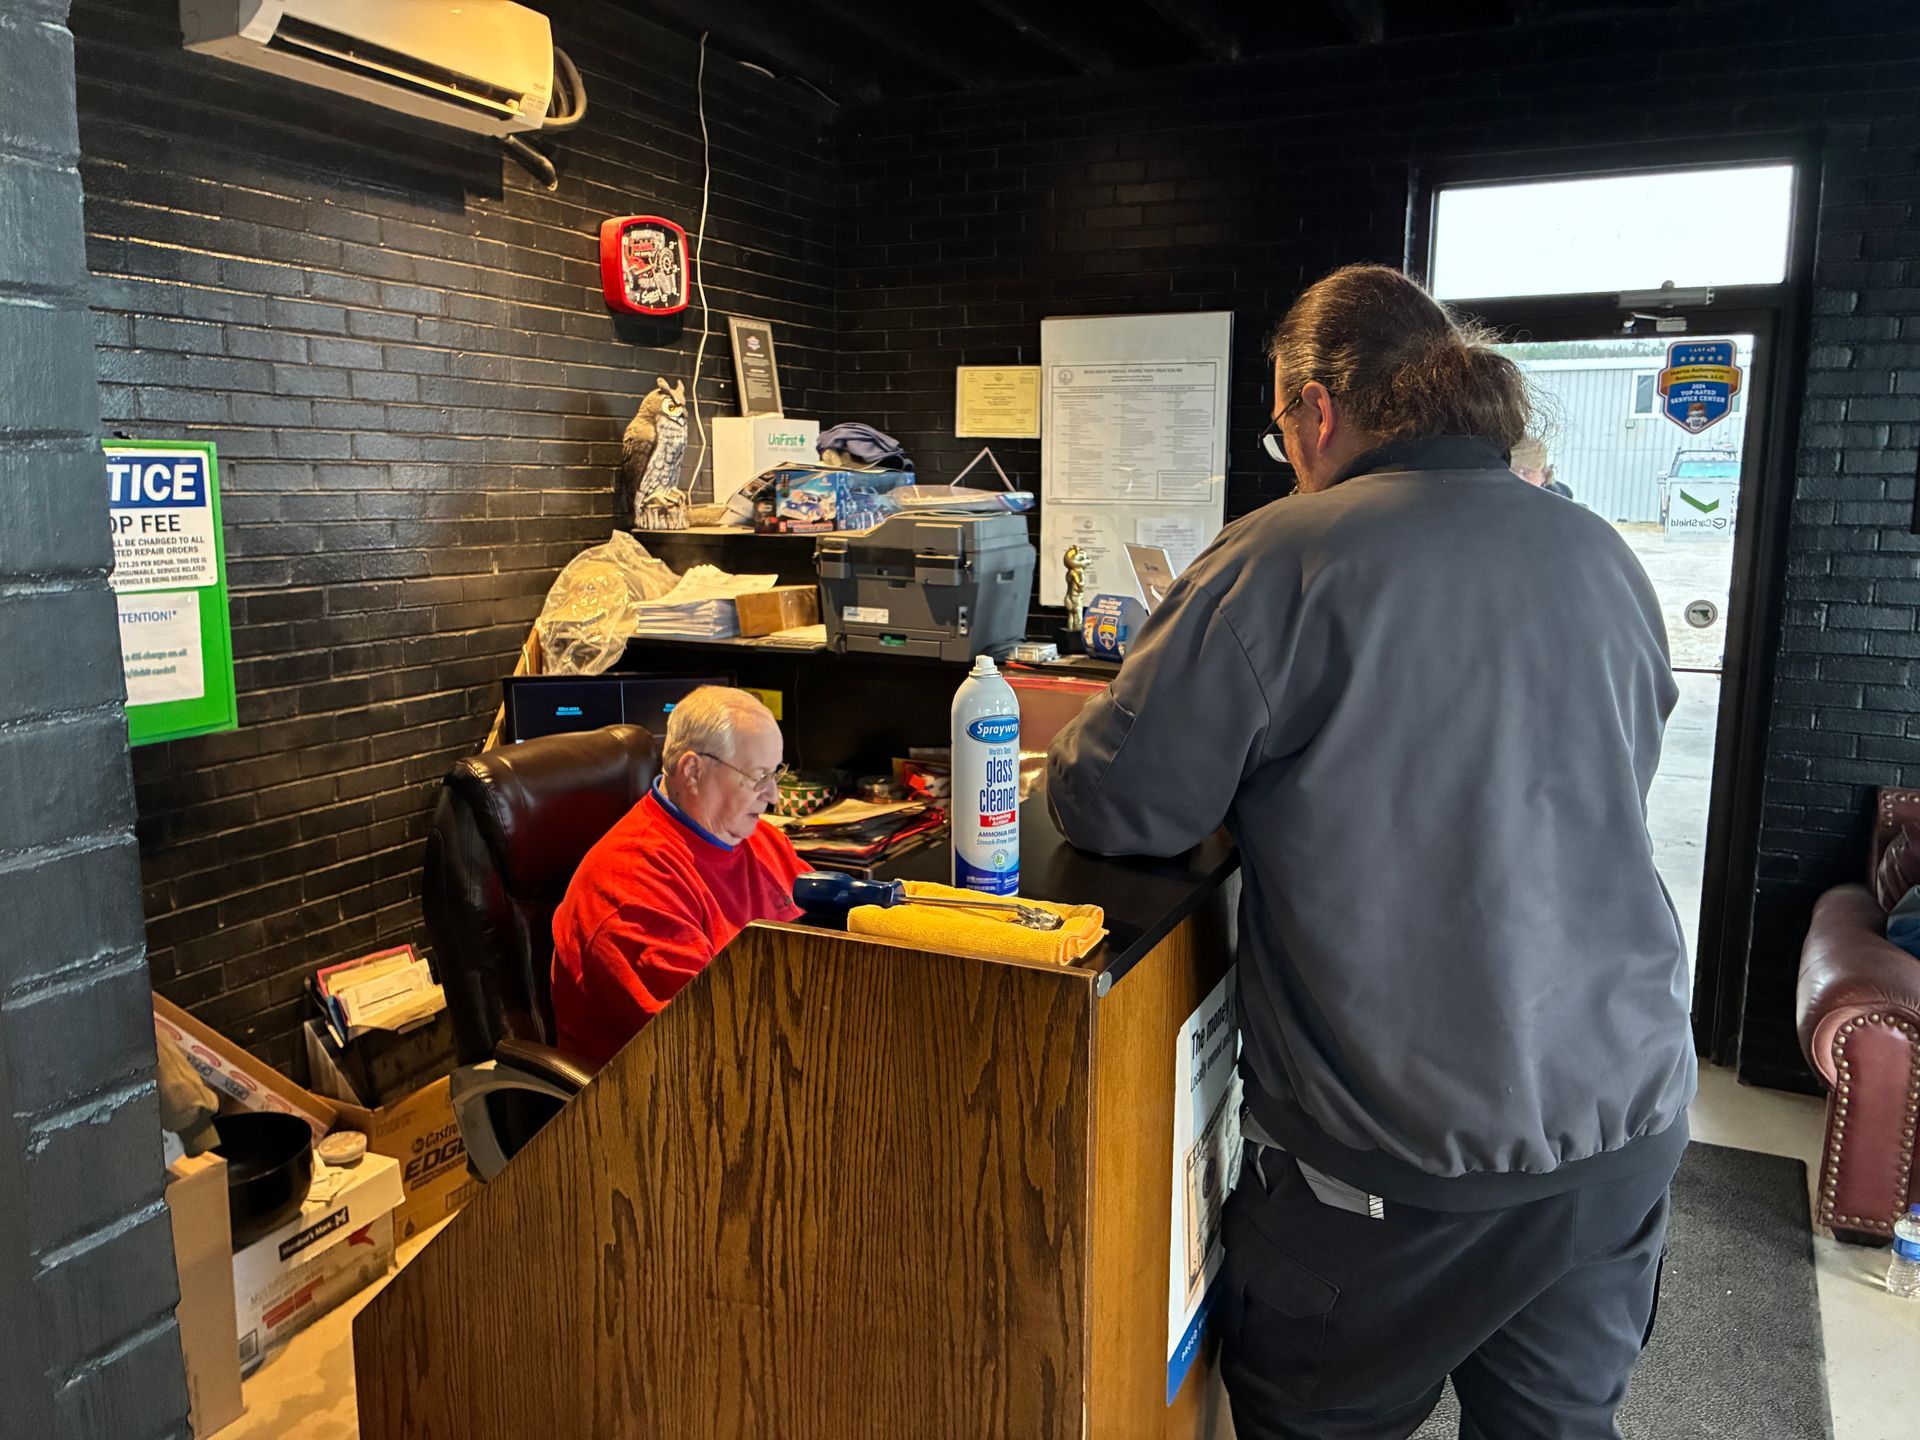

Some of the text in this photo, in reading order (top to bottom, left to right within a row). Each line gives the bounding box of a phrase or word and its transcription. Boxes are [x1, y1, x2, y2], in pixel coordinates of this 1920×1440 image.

[1670, 395, 1726, 404] SERVICE CENTER
[768, 433, 798, 446] UniFirst
[106, 463, 198, 502] TICE
[141, 514, 181, 533] FEE
[138, 538, 177, 546] CHARGED
[178, 536, 188, 544] TO
[191, 536, 204, 544] ALL
[134, 548, 164, 556] REPAIR
[166, 546, 198, 554] ORDERS
[119, 578, 144, 586] VEHICLE
[178, 648, 188, 656] all
[977, 722, 1018, 737] Sprayway
[986, 756, 1012, 788] glass
[980, 786, 1016, 812] cleaner
[978, 830, 1008, 838] AMMONIA
[976, 838, 1008, 846] Streak-Free
[1192, 999, 1229, 1059] The money
[1190, 1061, 1206, 1093] Locally
[315, 1222, 332, 1237] Mark
